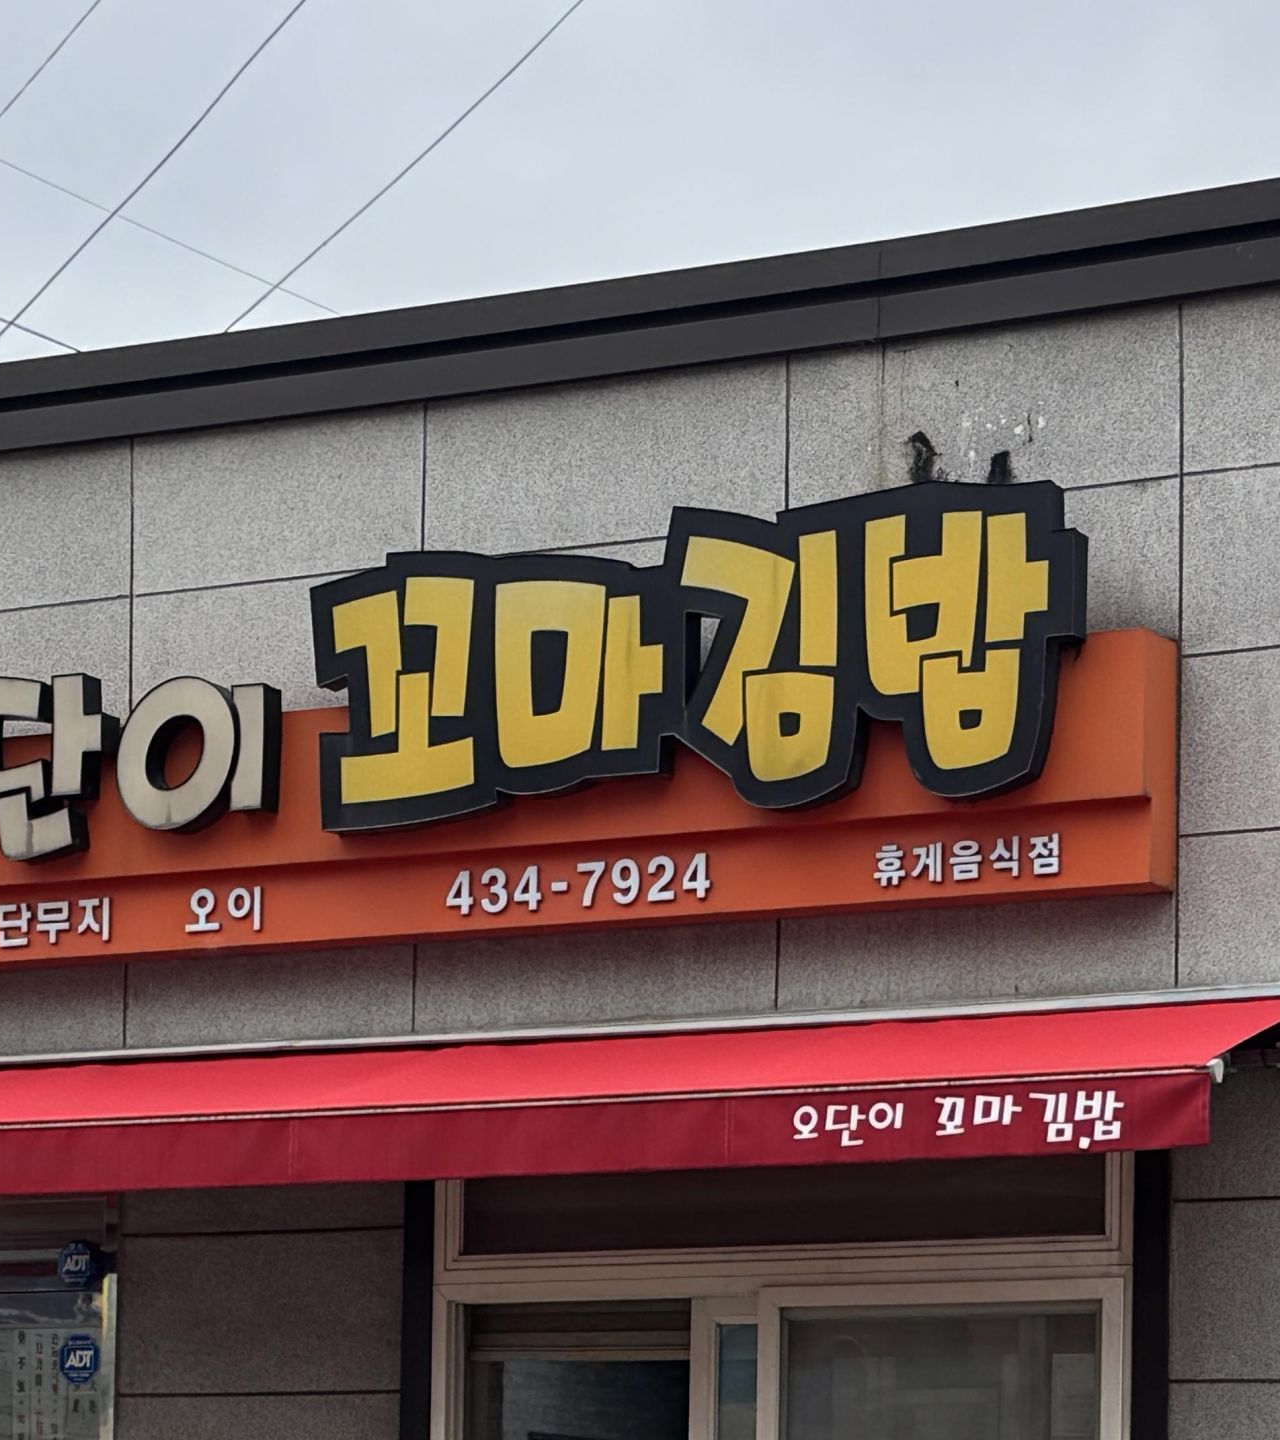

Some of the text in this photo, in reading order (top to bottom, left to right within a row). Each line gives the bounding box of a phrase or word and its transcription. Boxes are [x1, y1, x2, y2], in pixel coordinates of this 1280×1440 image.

[185, 885, 263, 932] 오이
[446, 852, 712, 916] 434-7924
[873, 833, 1062, 888] 휴게음식점
[793, 1102, 904, 1147] 오단이
[63, 1255, 90, 1272] ADT
[66, 1350, 93, 1368] ADT
